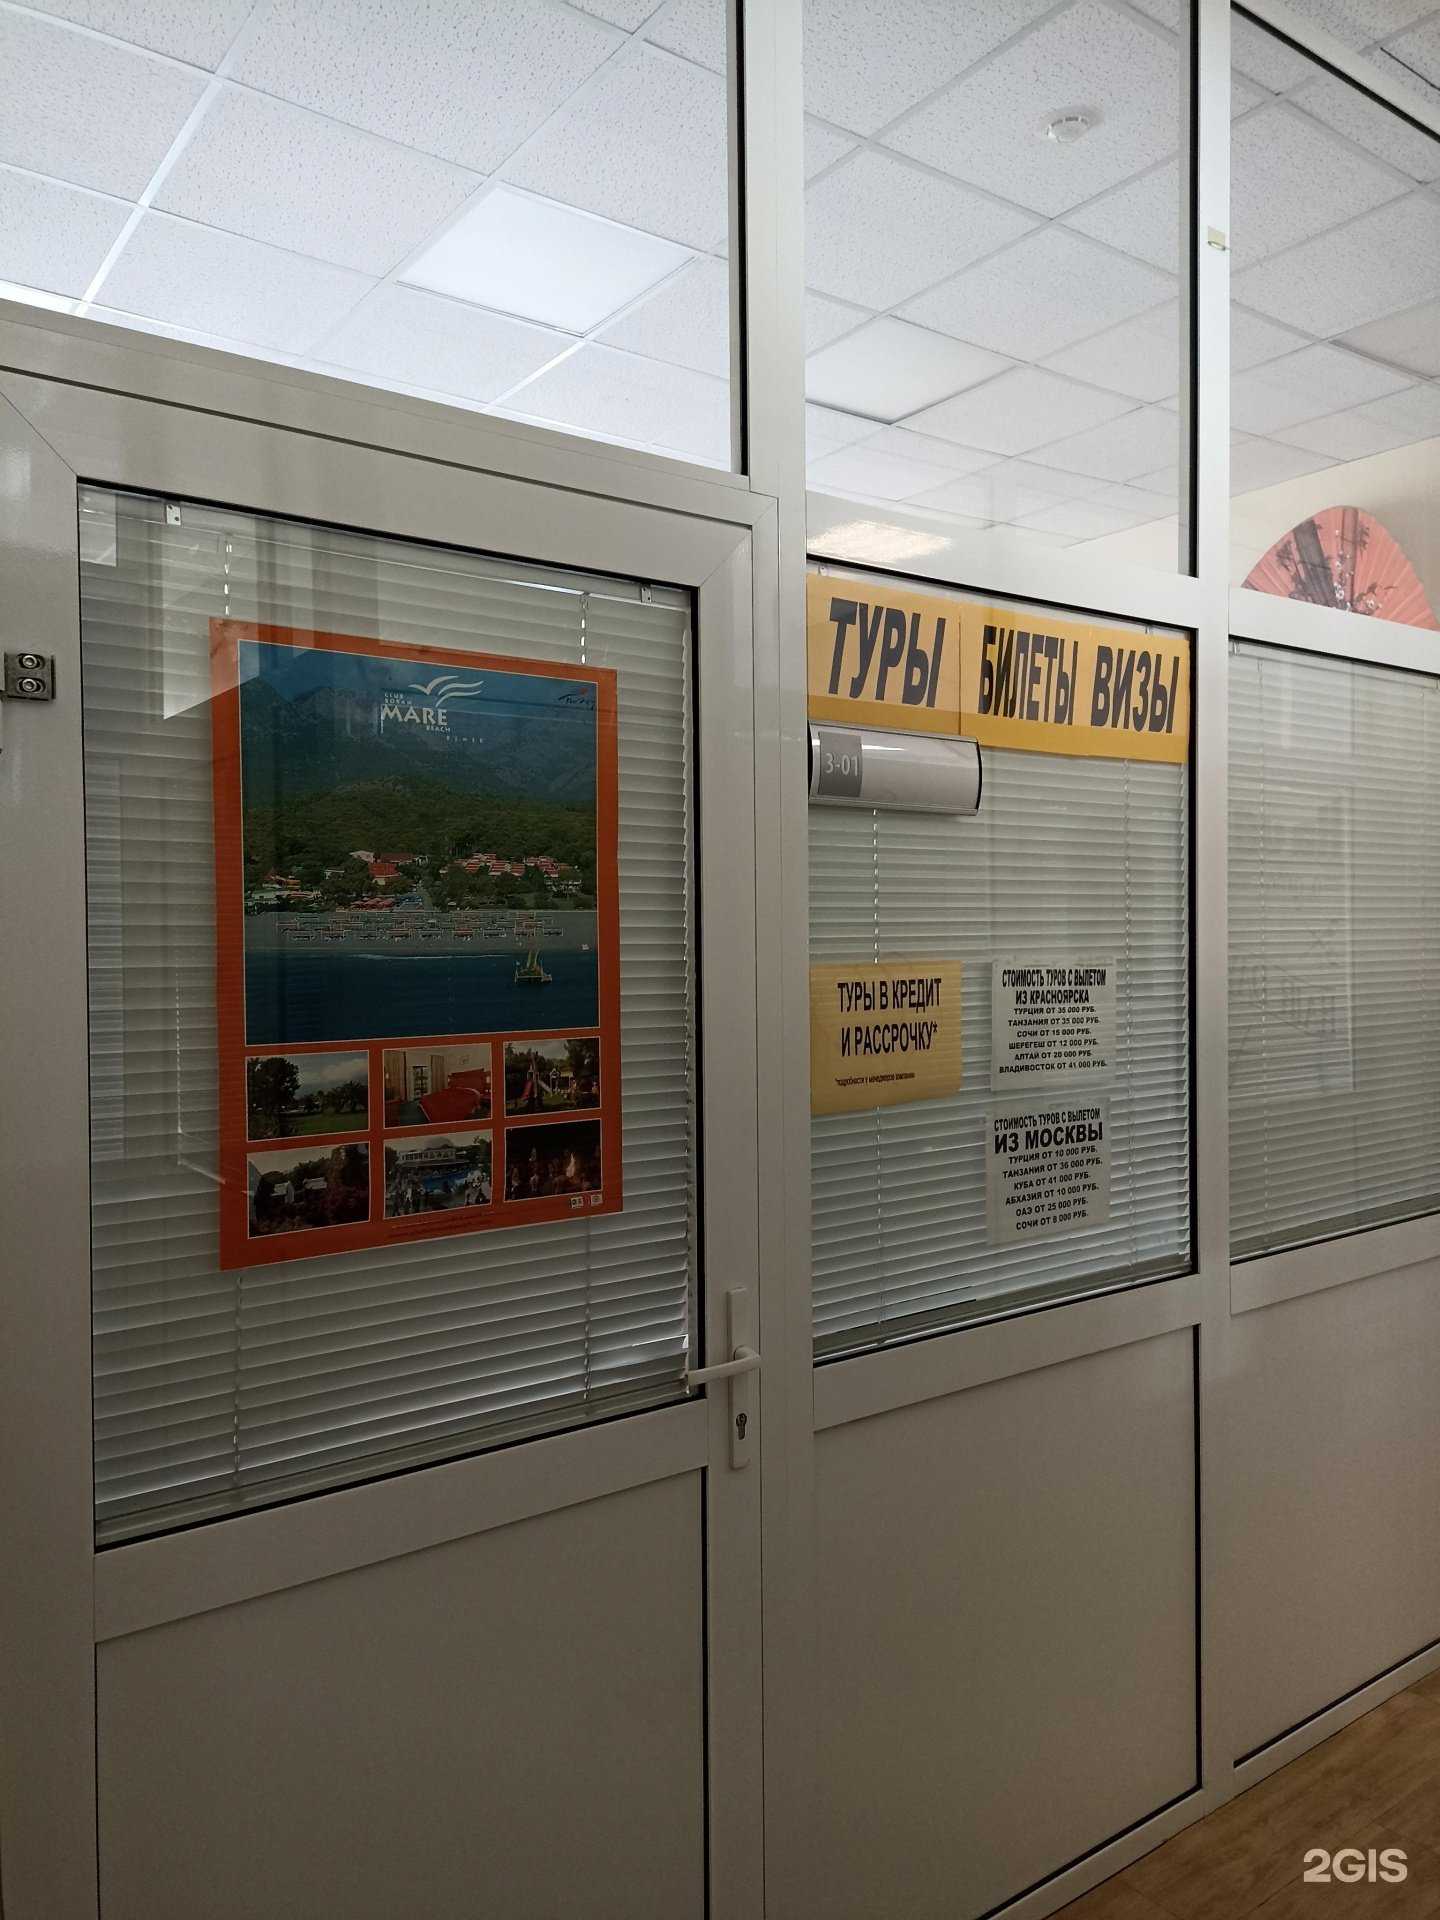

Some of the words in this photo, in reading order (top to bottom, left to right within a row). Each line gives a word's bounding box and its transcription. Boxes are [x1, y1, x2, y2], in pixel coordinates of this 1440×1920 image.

[828, 597, 946, 708] ТУРЫ
[977, 624, 1079, 726] БИЛЕТЫ
[1090, 645, 1180, 734] ВИЗЫ
[380, 703, 448, 732] MARE
[825, 752, 858, 776] 3-01
[1002, 969, 1044, 987] СТОИМОСТЬ
[1046, 969, 1066, 986] ТУРОВ
[1068, 969, 1073, 986] С
[1074, 969, 1106, 986] ВЫЛЕТОМ
[837, 981, 875, 1012] ТУРЫ
[879, 980, 889, 1010] В
[892, 978, 942, 1013] КРЕДИТ
[1015, 990, 1027, 1004] ИЗ
[1030, 989, 1089, 1004] КРАСНОЯРСКА
[1014, 1007, 1043, 1015] ТУРЦИЯ
[1008, 1018, 1048, 1026] ТАНЗАНИЯ
[841, 1026, 851, 1057] И
[1008, 1041, 1045, 1049] ШЕРЕГЕШ
[1000, 1063, 1055, 1073] ВЛАДИВОСТОК
[994, 1115, 1037, 1131] СТОИМОСТЬ
[1039, 1112, 1060, 1125] ТУРОВ
[1061, 1111, 1066, 1123] С
[1067, 1108, 1100, 1122] ВЫЛЕТОМ
[994, 1133, 1019, 1154] ИЗ
[1025, 1121, 1103, 1150] МОСКВЫ
[1009, 1152, 1040, 1164] ТУРЦИЯ
[1042, 1151, 1052, 1159] ОТ
[1055, 1149, 1064, 1157] 10
[1066, 1147, 1079, 1156] 000
[1081, 1145, 1097, 1154] РУБ.
[1003, 1164, 1045, 1179] ТАНЗАНИЯ
[1047, 1163, 1057, 1171] ОТ
[1071, 1159, 1084, 1168] 000
[1086, 1157, 1103, 1165] РУБ.
[1014, 1180, 1034, 1190] КУБА
[1036, 1178, 1046, 1186] ОТ
[1060, 1174, 1073, 1183] 000
[1075, 1171, 1091, 1180] РУБ.
[1006, 1191, 1042, 1205] АБХАЗИЯ
[1044, 1189, 1054, 1198] ОТ
[1057, 1187, 1066, 1195] 10
[1068, 1185, 1081, 1194] 000
[1083, 1182, 1099, 1191] РУБ.
[1016, 1206, 1033, 1216] ОАЭ
[1035, 1204, 1045, 1213] ОТ
[1058, 1200, 1071, 1209] 000
[1073, 1197, 1088, 1206] РУБ.
[1016, 1219, 1039, 1230] СОЧИ
[1040, 1217, 1051, 1226] ОТ
[1059, 1212, 1072, 1222] 000
[1073, 1209, 1088, 1218] РУБ.
